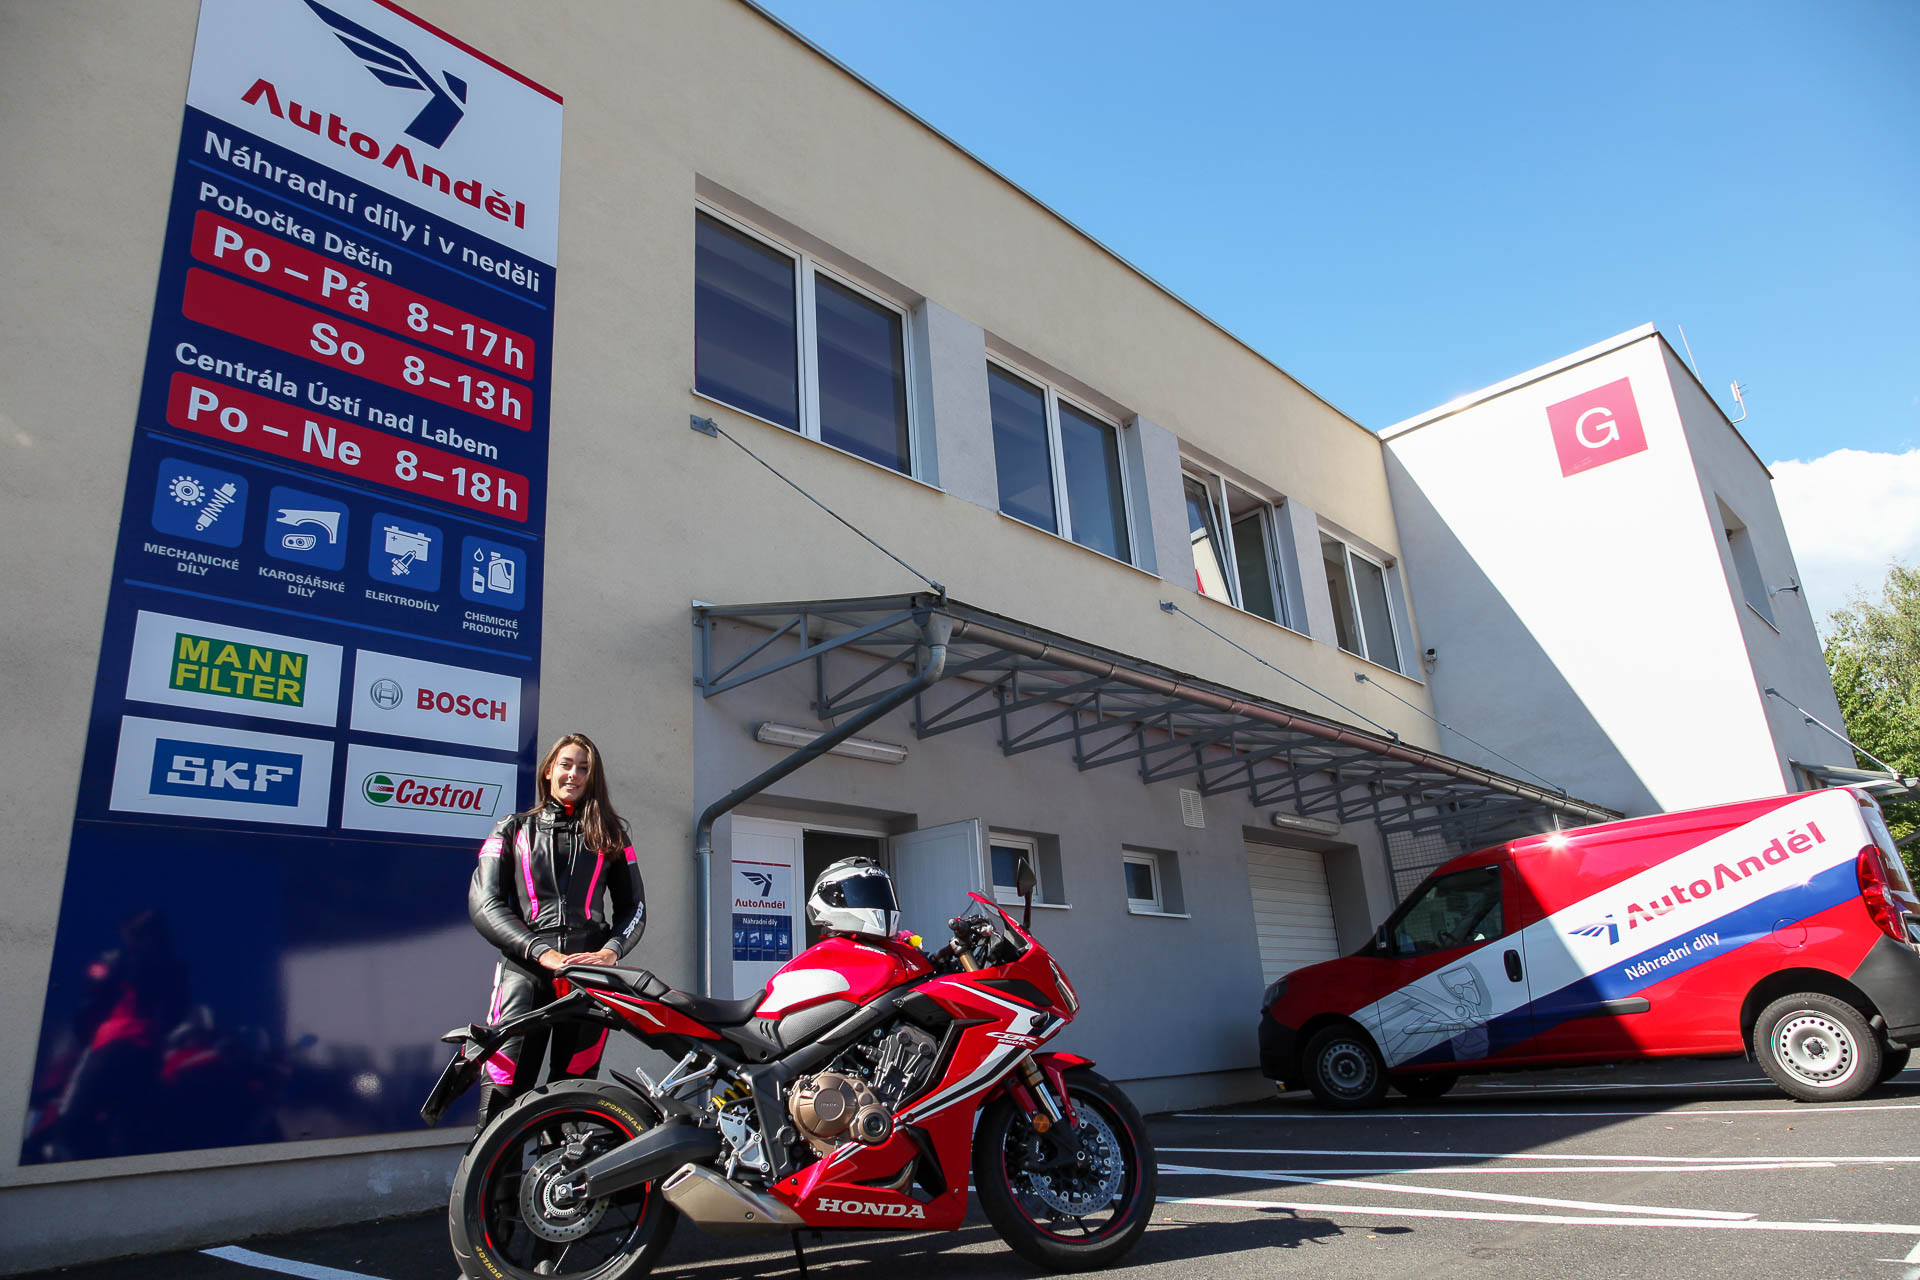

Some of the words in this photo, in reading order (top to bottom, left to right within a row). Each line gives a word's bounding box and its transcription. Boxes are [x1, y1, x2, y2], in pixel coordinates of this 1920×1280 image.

[240, 78, 526, 230] AutoAnděl
[200, 182, 315, 245] Pobočka
[325, 232, 393, 276] Děčín
[204, 130, 355, 214] Náhradní
[363, 203, 416, 241] díly
[423, 225, 431, 246] i
[438, 236, 455, 255] v
[462, 244, 540, 293] neděli
[213, 225, 271, 273] Po
[321, 266, 370, 313] Pá
[310, 322, 365, 366] So
[175, 342, 297, 398] Centrála
[308, 381, 362, 417] Ústí
[368, 405, 414, 434] nad
[421, 419, 498, 461] Labem
[187, 386, 248, 433] Po
[302, 420, 362, 467] Ne
[1575, 406, 1620, 449] G
[143, 542, 240, 570] MECHANICKÉ
[176, 562, 209, 576] DÍLY
[258, 566, 345, 593] KAROSÁŘSKÉ
[287, 583, 316, 598] DÍLY
[365, 589, 440, 613] ELEKTRODÍLY
[462, 621, 519, 640] PRODUKTY
[464, 611, 519, 629] CHEMICKÉ
[179, 637, 303, 678] MANN
[175, 663, 301, 703] FILTER
[416, 688, 507, 722] BOSCH
[166, 755, 294, 793] SKF
[395, 778, 484, 812] Castrol
[1627, 821, 1826, 930] AutoAnděl
[735, 898, 785, 909] AutoAnděl
[1624, 942, 1691, 981] Náhradní
[1691, 930, 1720, 953] díly
[985, 1031, 1039, 1046] CBR
[815, 1197, 926, 1219] HONDA
[475, 1245, 504, 1279] DUNLOP
